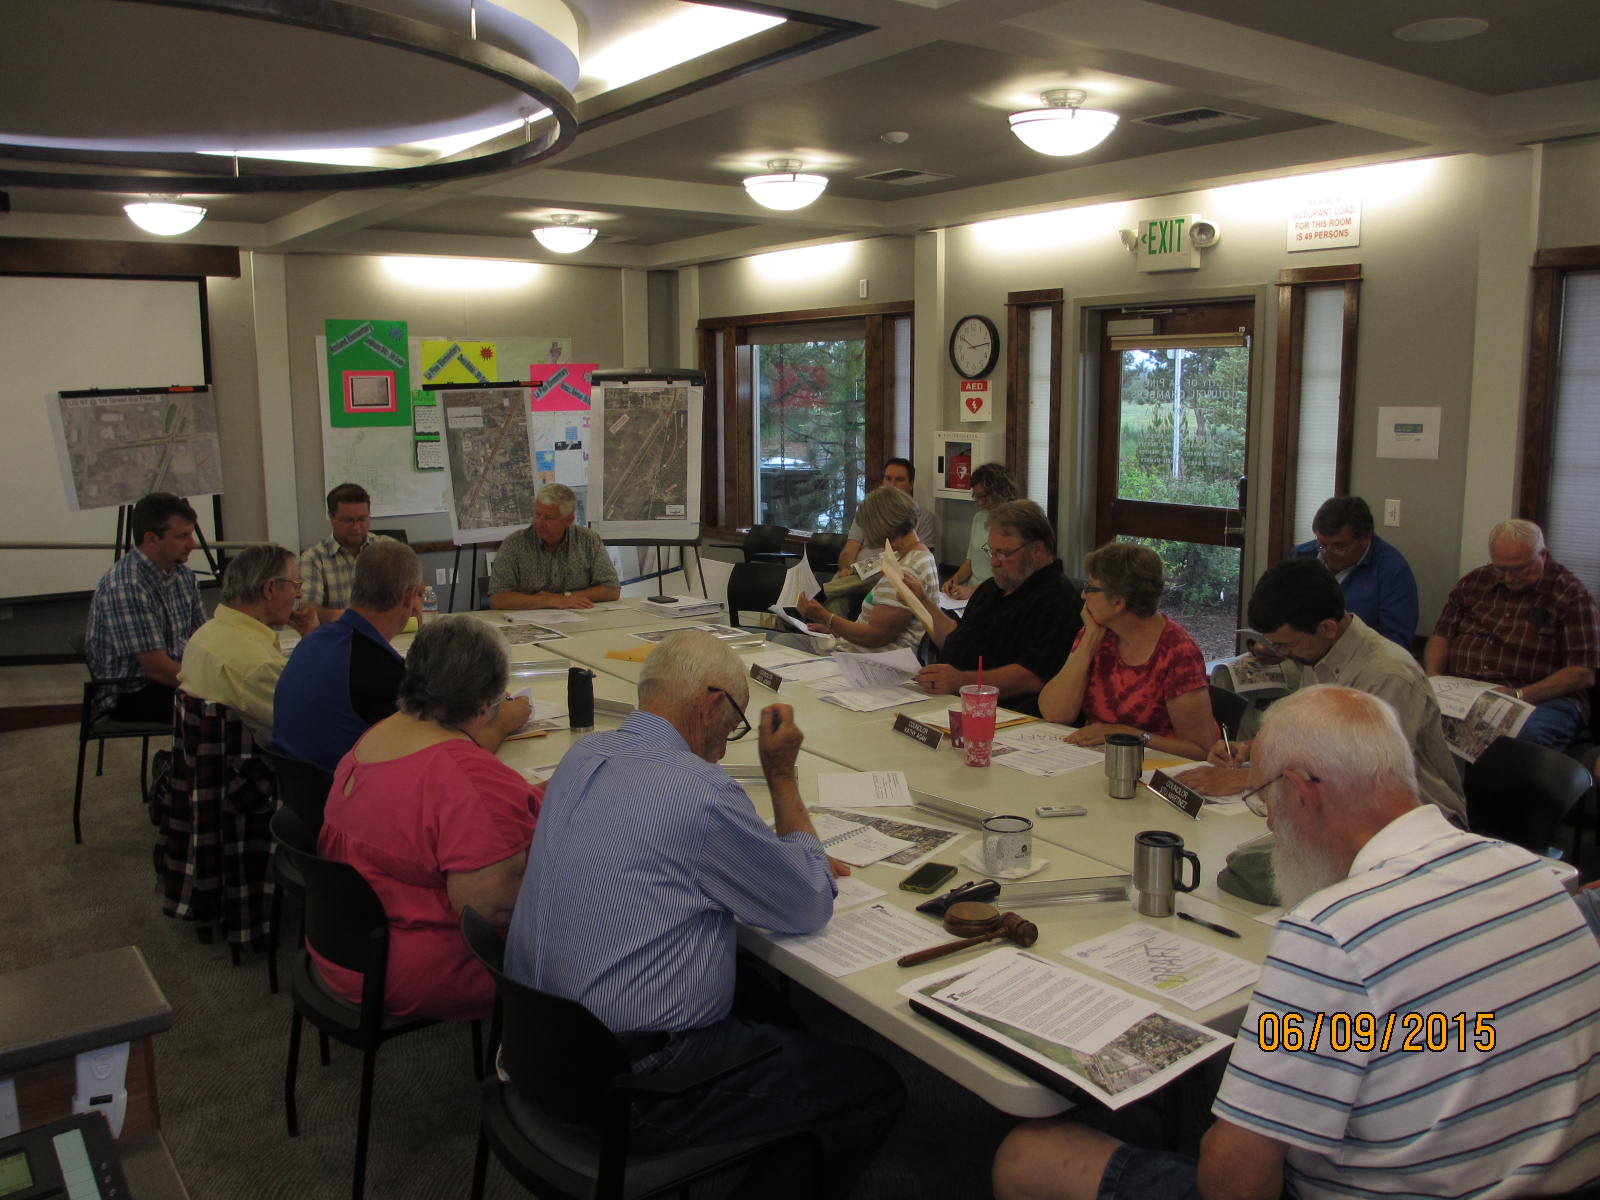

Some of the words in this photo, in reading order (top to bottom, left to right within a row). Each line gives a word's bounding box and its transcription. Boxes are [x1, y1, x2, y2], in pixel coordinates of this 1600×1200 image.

[1293, 208, 1333, 219] OCCUPANT
[1335, 206, 1355, 215] LOAD
[1295, 221, 1310, 231] FOR
[1311, 220, 1327, 229] THIS
[1329, 217, 1352, 227] ROOM
[1148, 218, 1185, 255] EXIT
[1296, 232, 1303, 241] IS
[1304, 231, 1313, 240] 49
[1314, 228, 1350, 239] PERSONS
[965, 382, 983, 391] AED
[1143, 943, 1188, 983] DRAFT
